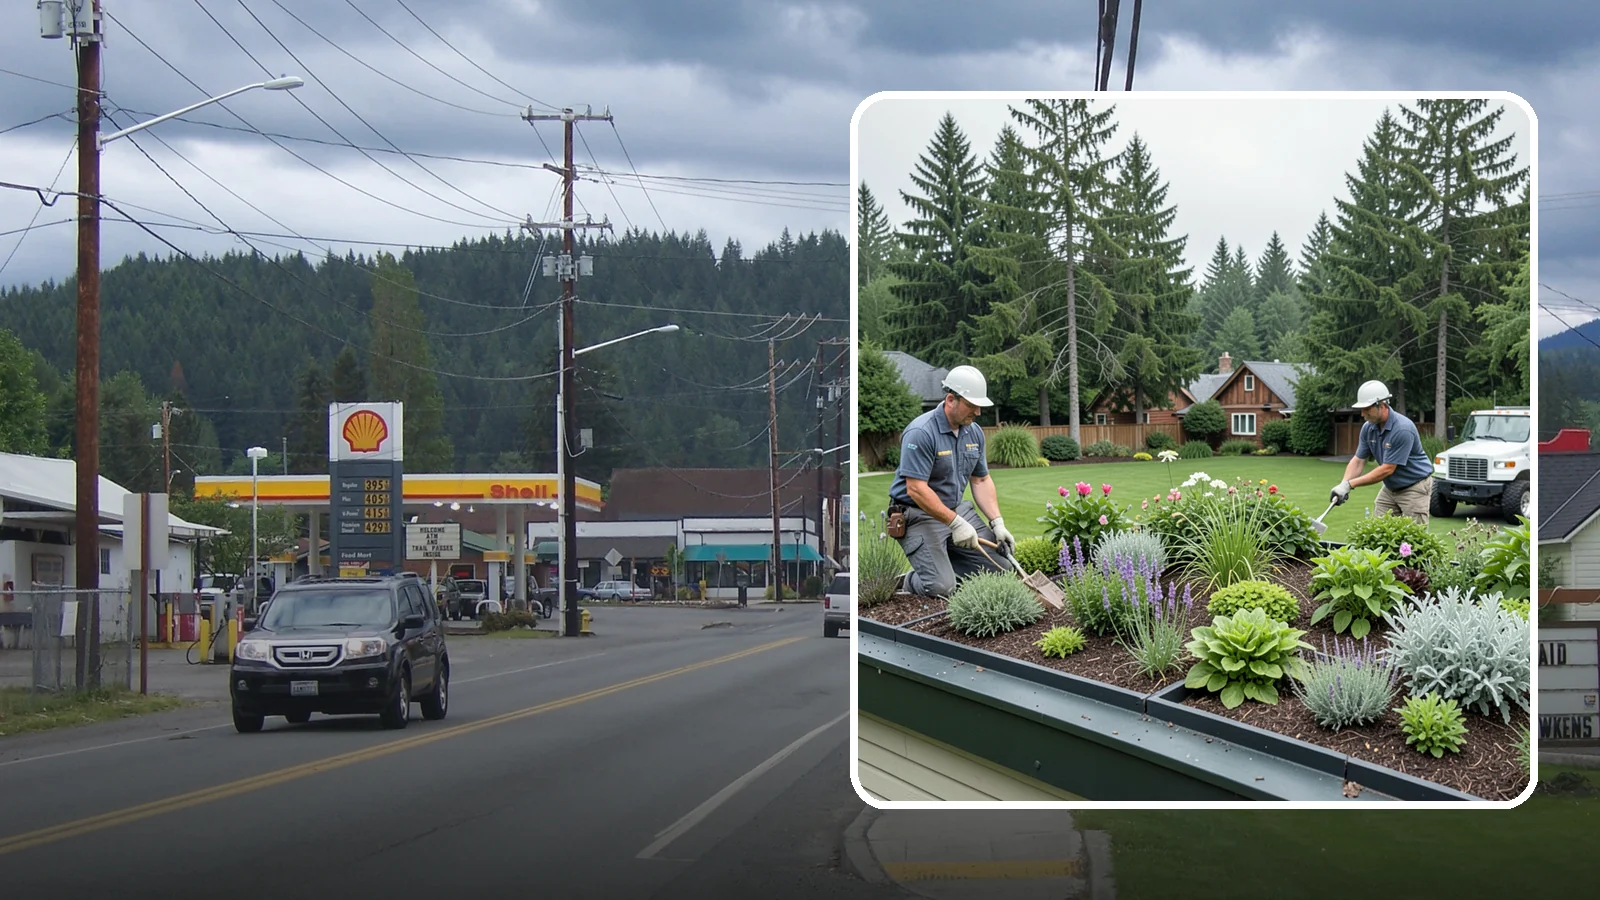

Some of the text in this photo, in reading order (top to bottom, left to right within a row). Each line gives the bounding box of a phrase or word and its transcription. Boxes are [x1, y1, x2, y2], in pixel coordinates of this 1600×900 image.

[365, 480, 384, 490] 395
[490, 484, 547, 499] Shell
[365, 494, 384, 504] 405
[365, 508, 384, 518] 415
[365, 522, 384, 533] 429
